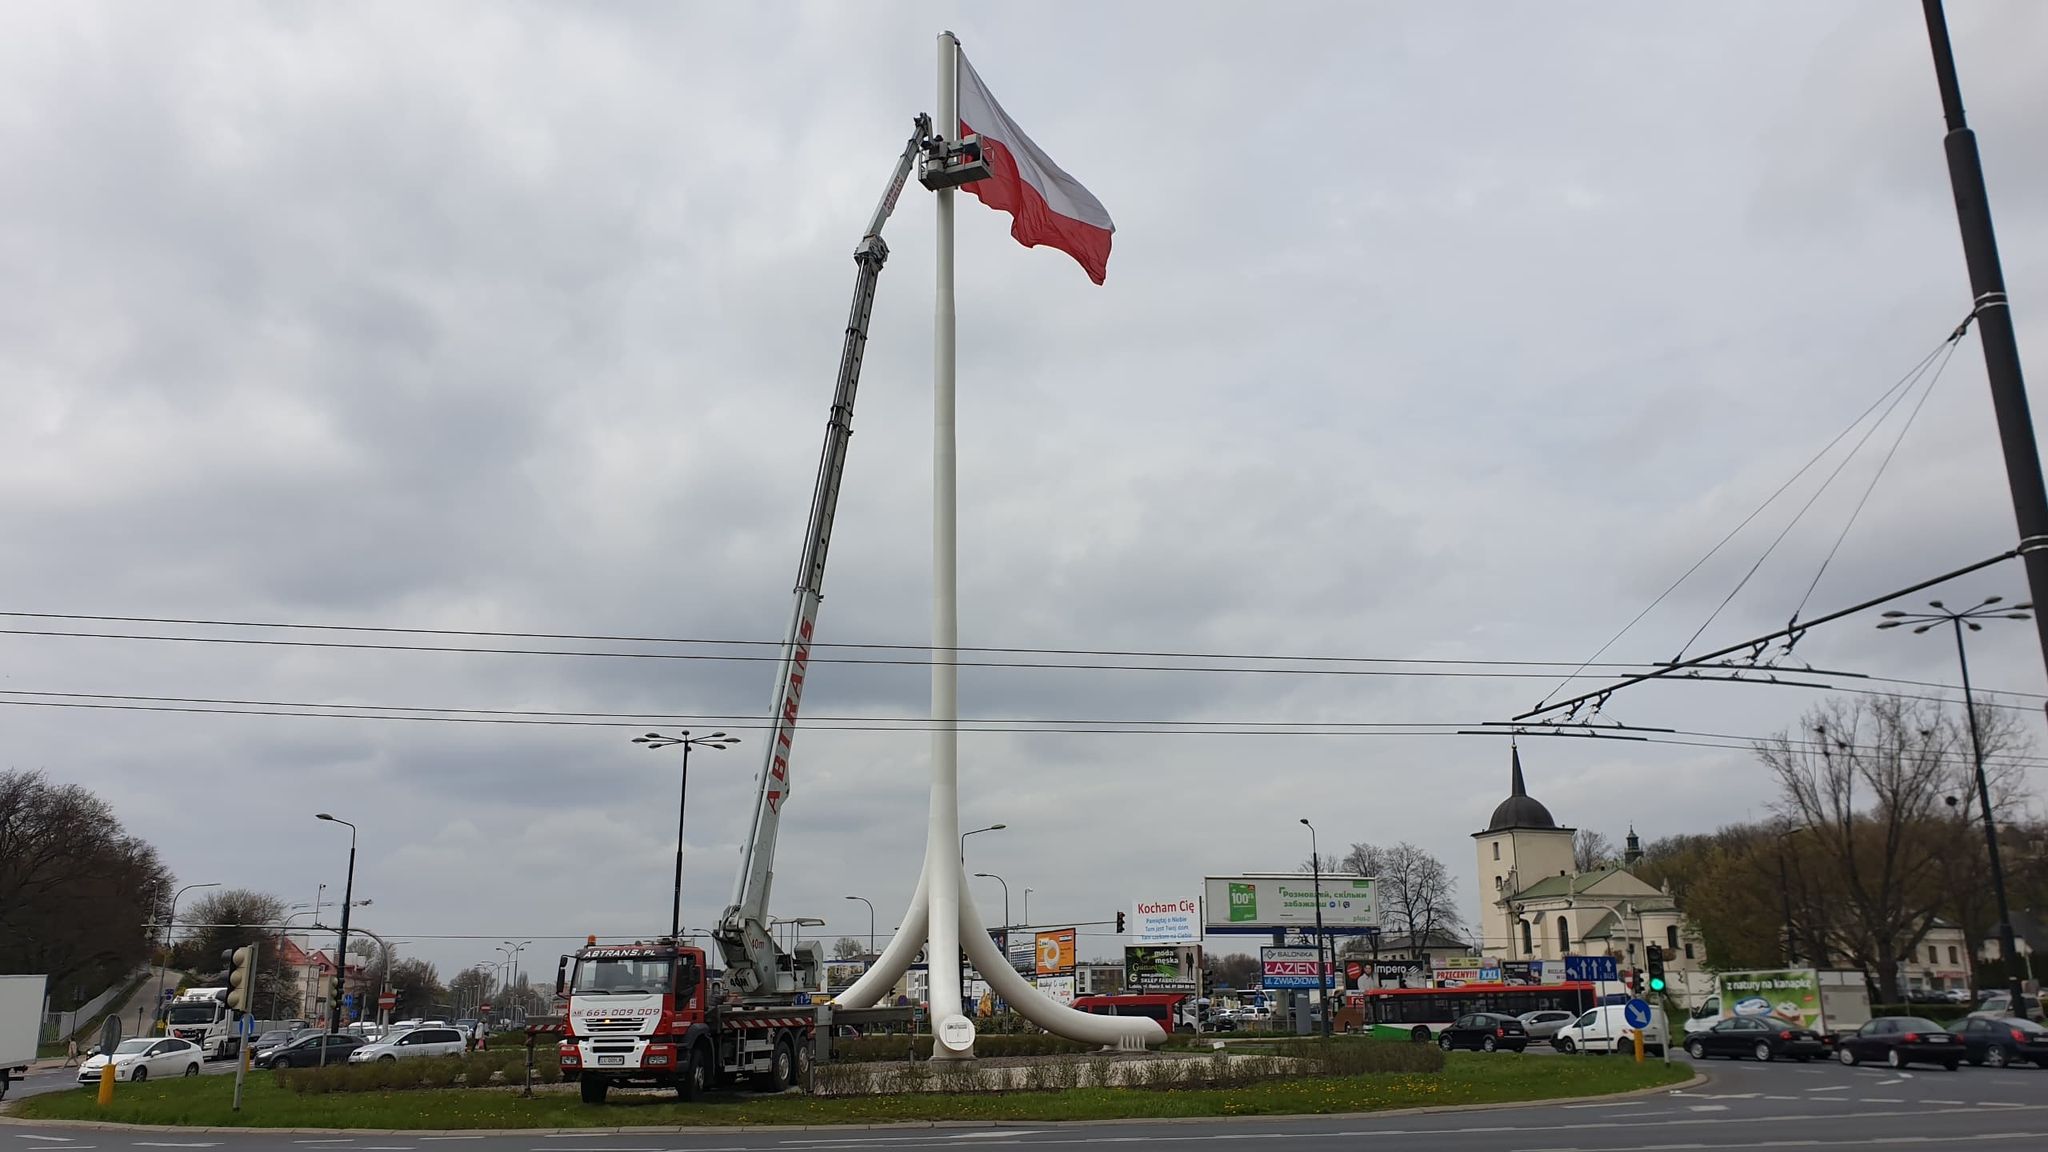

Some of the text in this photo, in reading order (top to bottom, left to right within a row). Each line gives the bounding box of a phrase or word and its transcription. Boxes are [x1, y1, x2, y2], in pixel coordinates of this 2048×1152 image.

[767, 616, 814, 815] ABTRANS
[1138, 900, 1195, 914] Kocham Cię
[1155, 957, 1179, 965] męska
[1264, 963, 1331, 974] ŁAZIENI
[1374, 963, 1407, 975] impero
[1481, 970, 1497, 979] XXL
[1733, 981, 1760, 991] natury
[1761, 980, 1772, 989] na
[587, 1009, 607, 1017] 665
[611, 1009, 633, 1017] 009
[637, 1008, 660, 1016] 009
